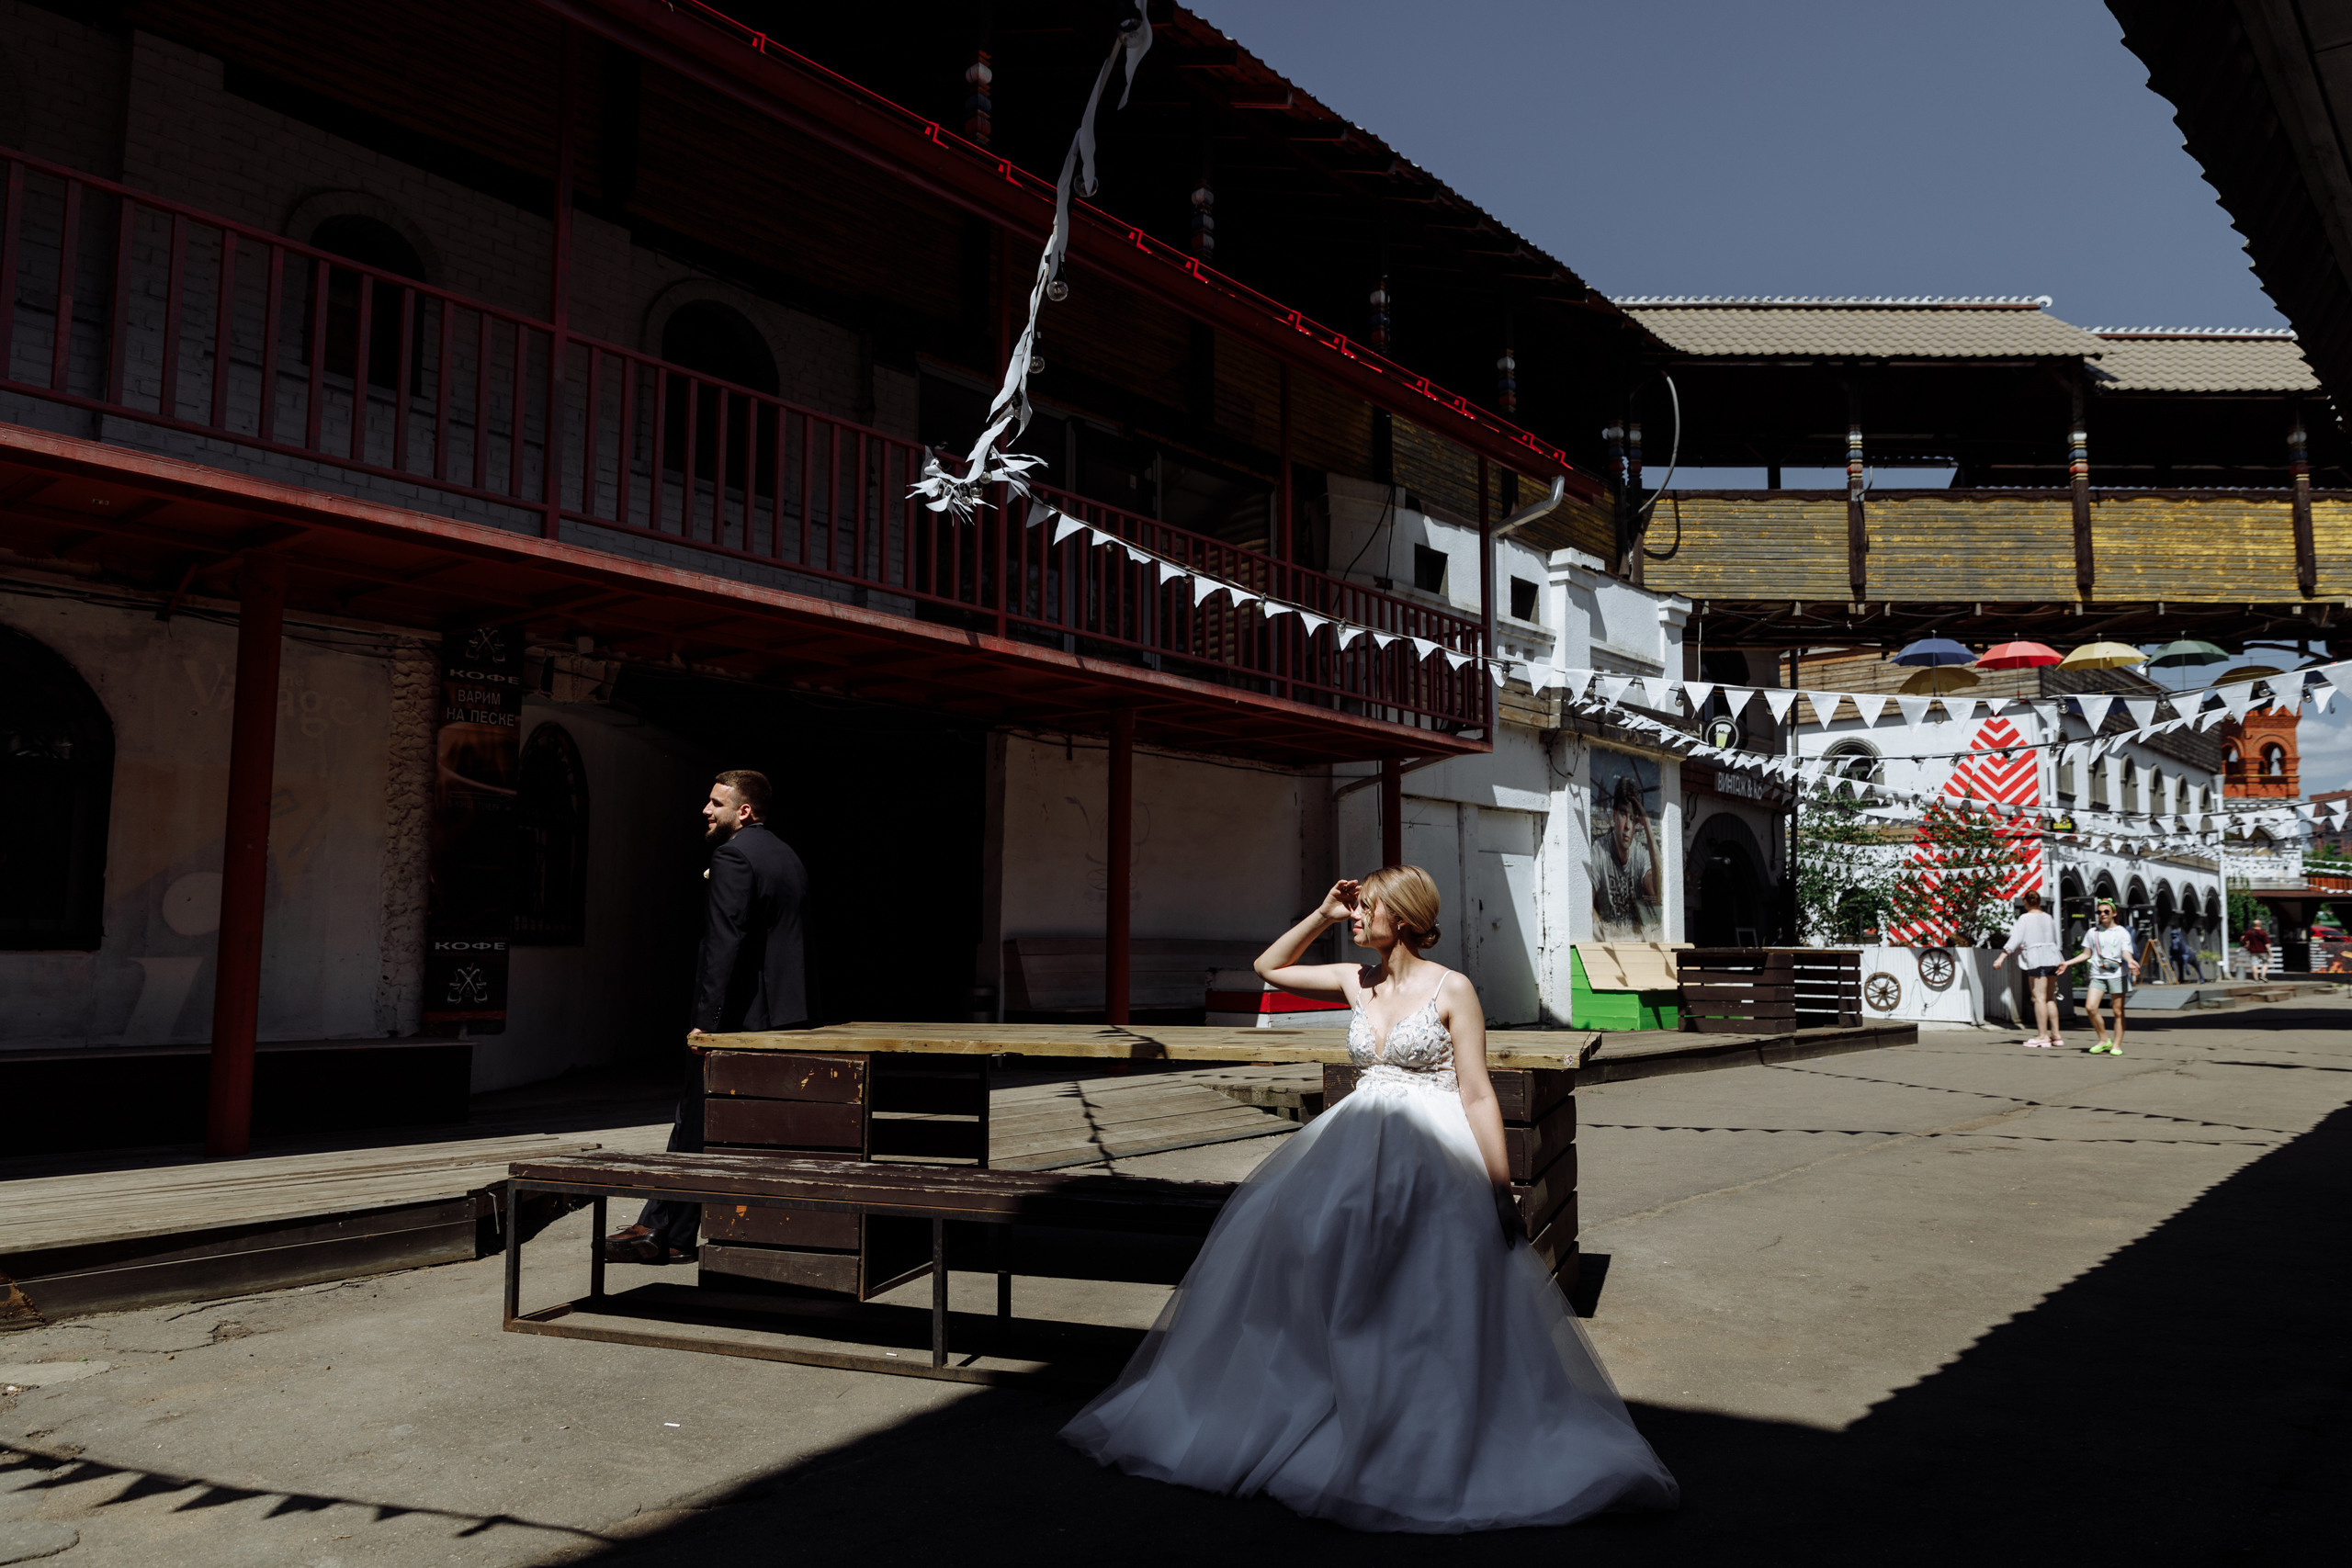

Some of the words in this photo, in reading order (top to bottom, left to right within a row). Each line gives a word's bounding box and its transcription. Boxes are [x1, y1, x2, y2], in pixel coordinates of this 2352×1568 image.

[449, 669, 521, 685] КОФЕ
[182, 660, 368, 738] Viage
[458, 689, 501, 705] ВАРИМ
[447, 706, 465, 722] НА
[470, 709, 514, 728] ПЕСКЕ
[1718, 772, 1747, 797] ВИНТАЖ
[1747, 779, 1752, 797] &
[434, 942, 506, 951] КОФЕ
